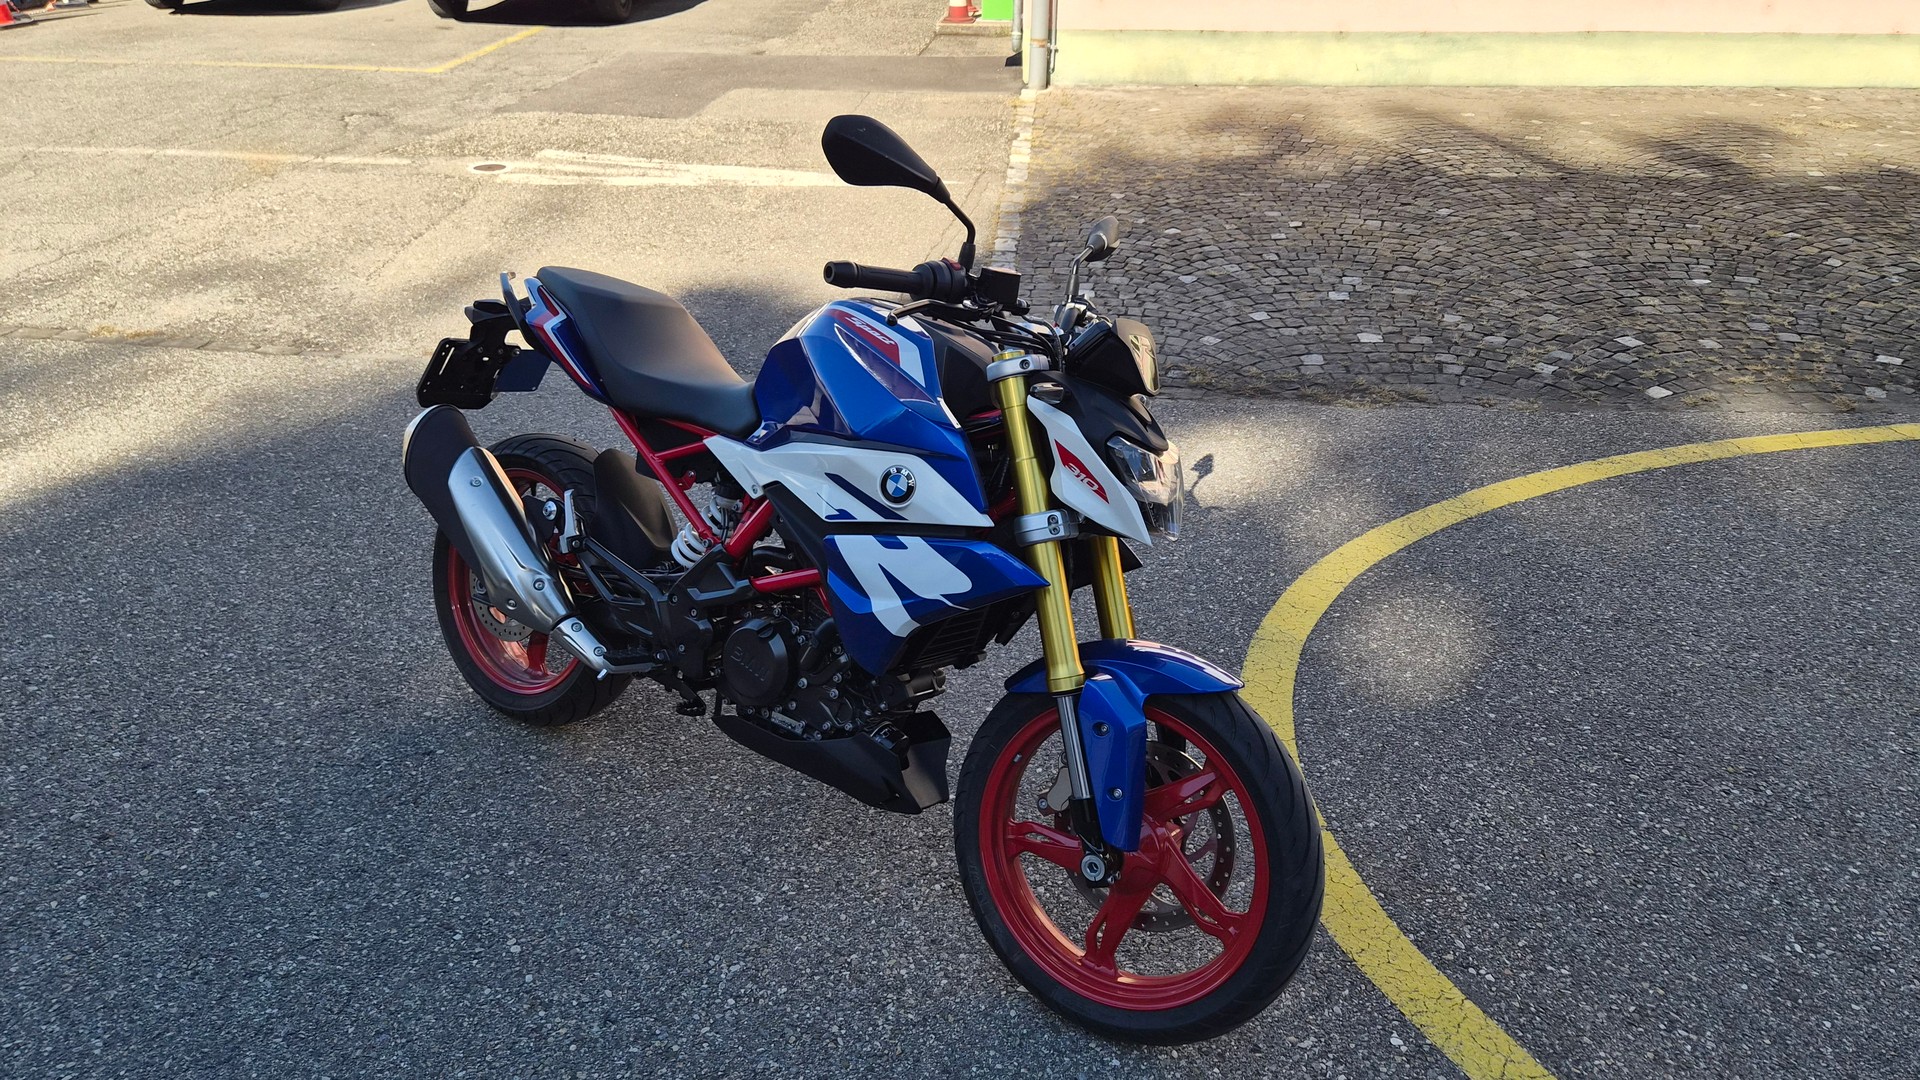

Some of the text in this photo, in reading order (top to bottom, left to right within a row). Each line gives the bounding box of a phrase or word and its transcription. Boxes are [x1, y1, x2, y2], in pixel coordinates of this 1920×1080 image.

[844, 316, 897, 346] Speed
[890, 467, 915, 487] BMW
[1064, 462, 1099, 491] 310
